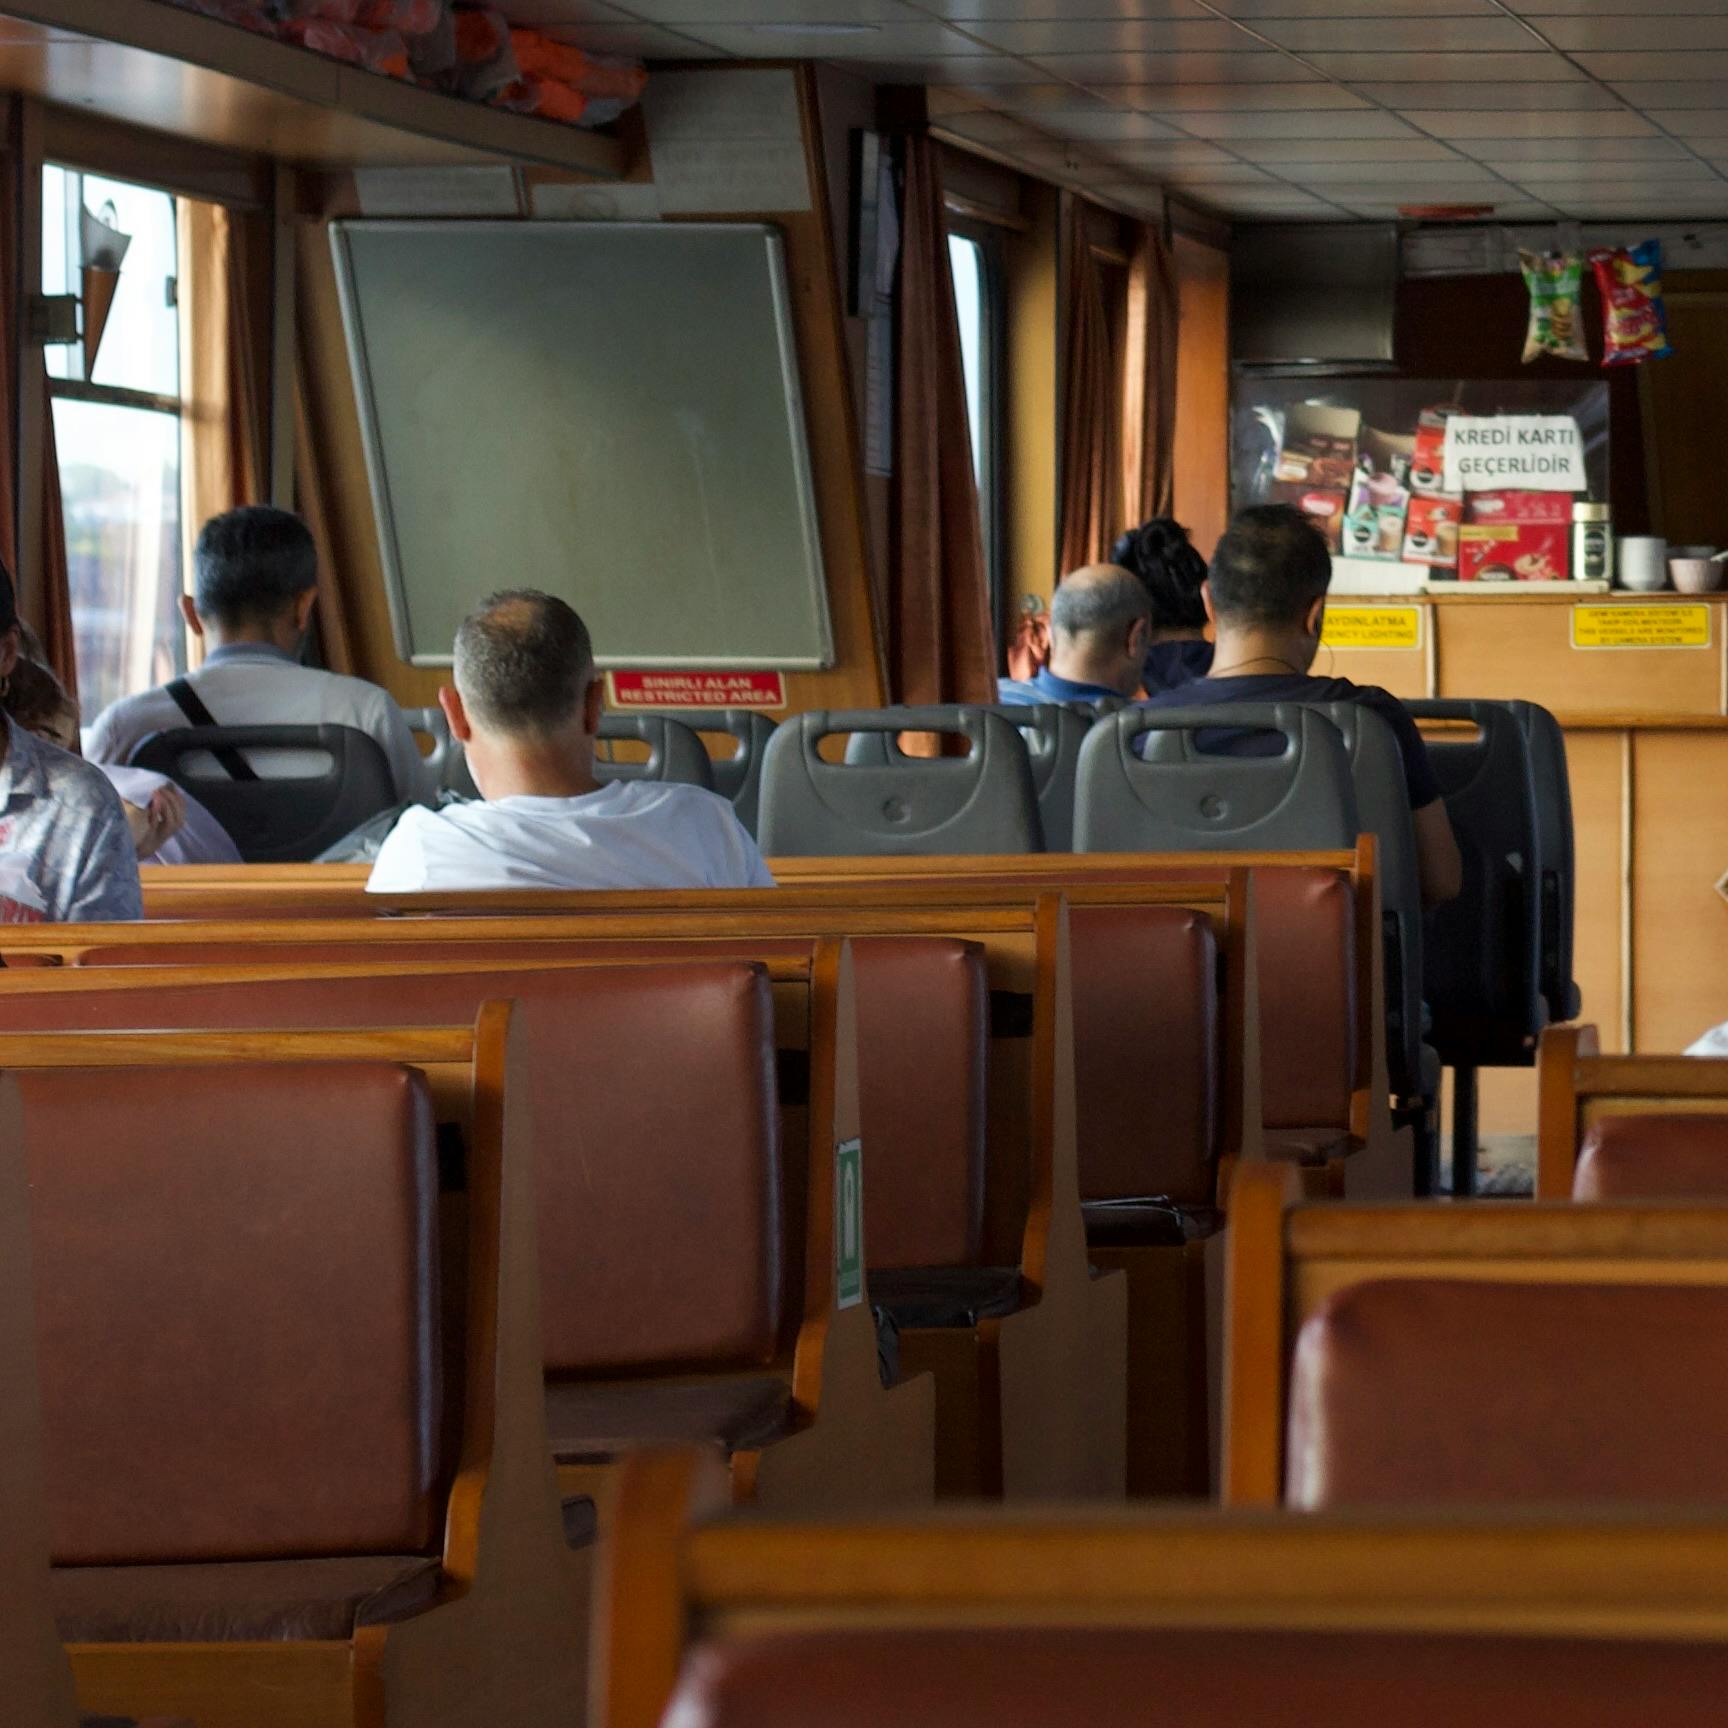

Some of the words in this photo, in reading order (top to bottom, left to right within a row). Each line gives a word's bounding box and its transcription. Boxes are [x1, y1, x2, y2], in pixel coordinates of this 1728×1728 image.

[1454, 425, 1511, 445] KREDİ
[1517, 428, 1574, 445] KARTI
[1458, 453, 1570, 476] GEÇERLİDİR
[641, 676, 702, 689] SINIRLI
[705, 676, 752, 689] ALAN
[620, 689, 726, 703] RESTRICTED
[730, 690, 777, 702] AREA
